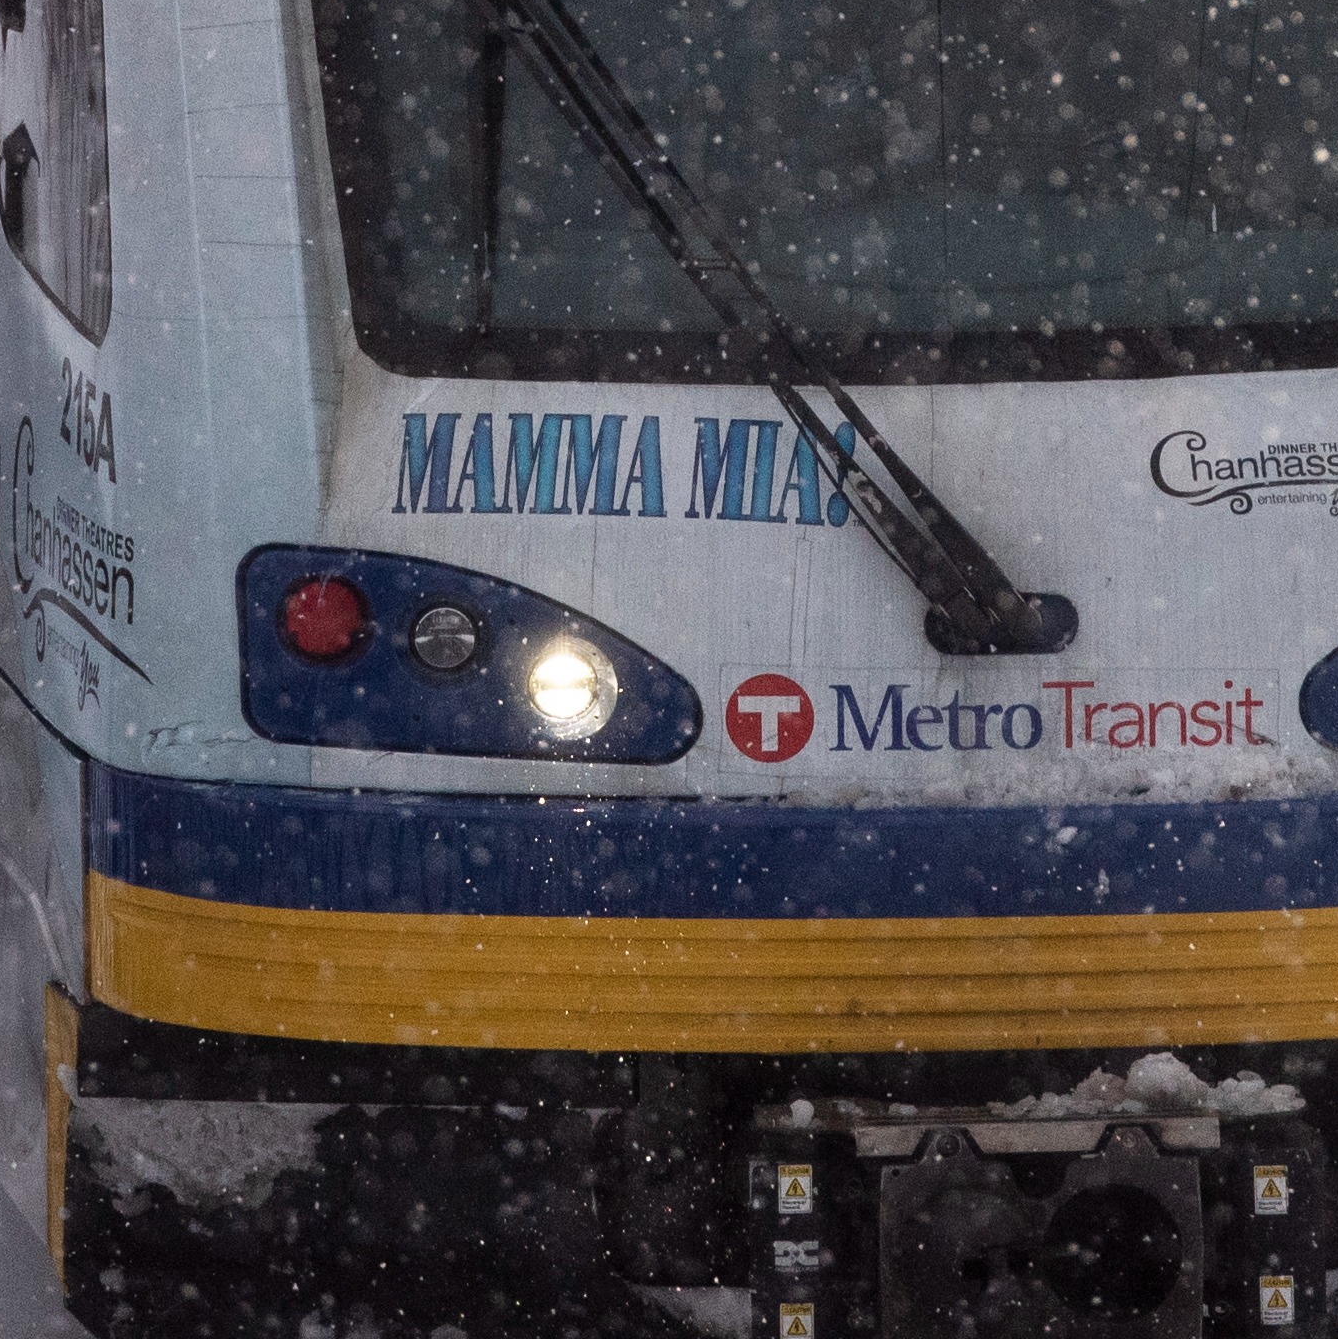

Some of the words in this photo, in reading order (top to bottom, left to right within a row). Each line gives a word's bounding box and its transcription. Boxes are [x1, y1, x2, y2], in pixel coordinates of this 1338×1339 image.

[60, 357, 117, 485] 215A
[392, 413, 667, 519] MAMMA
[1267, 443, 1317, 455] DINNER
[13, 416, 135, 625] Chanhassen
[1257, 492, 1328, 506] entertaining
